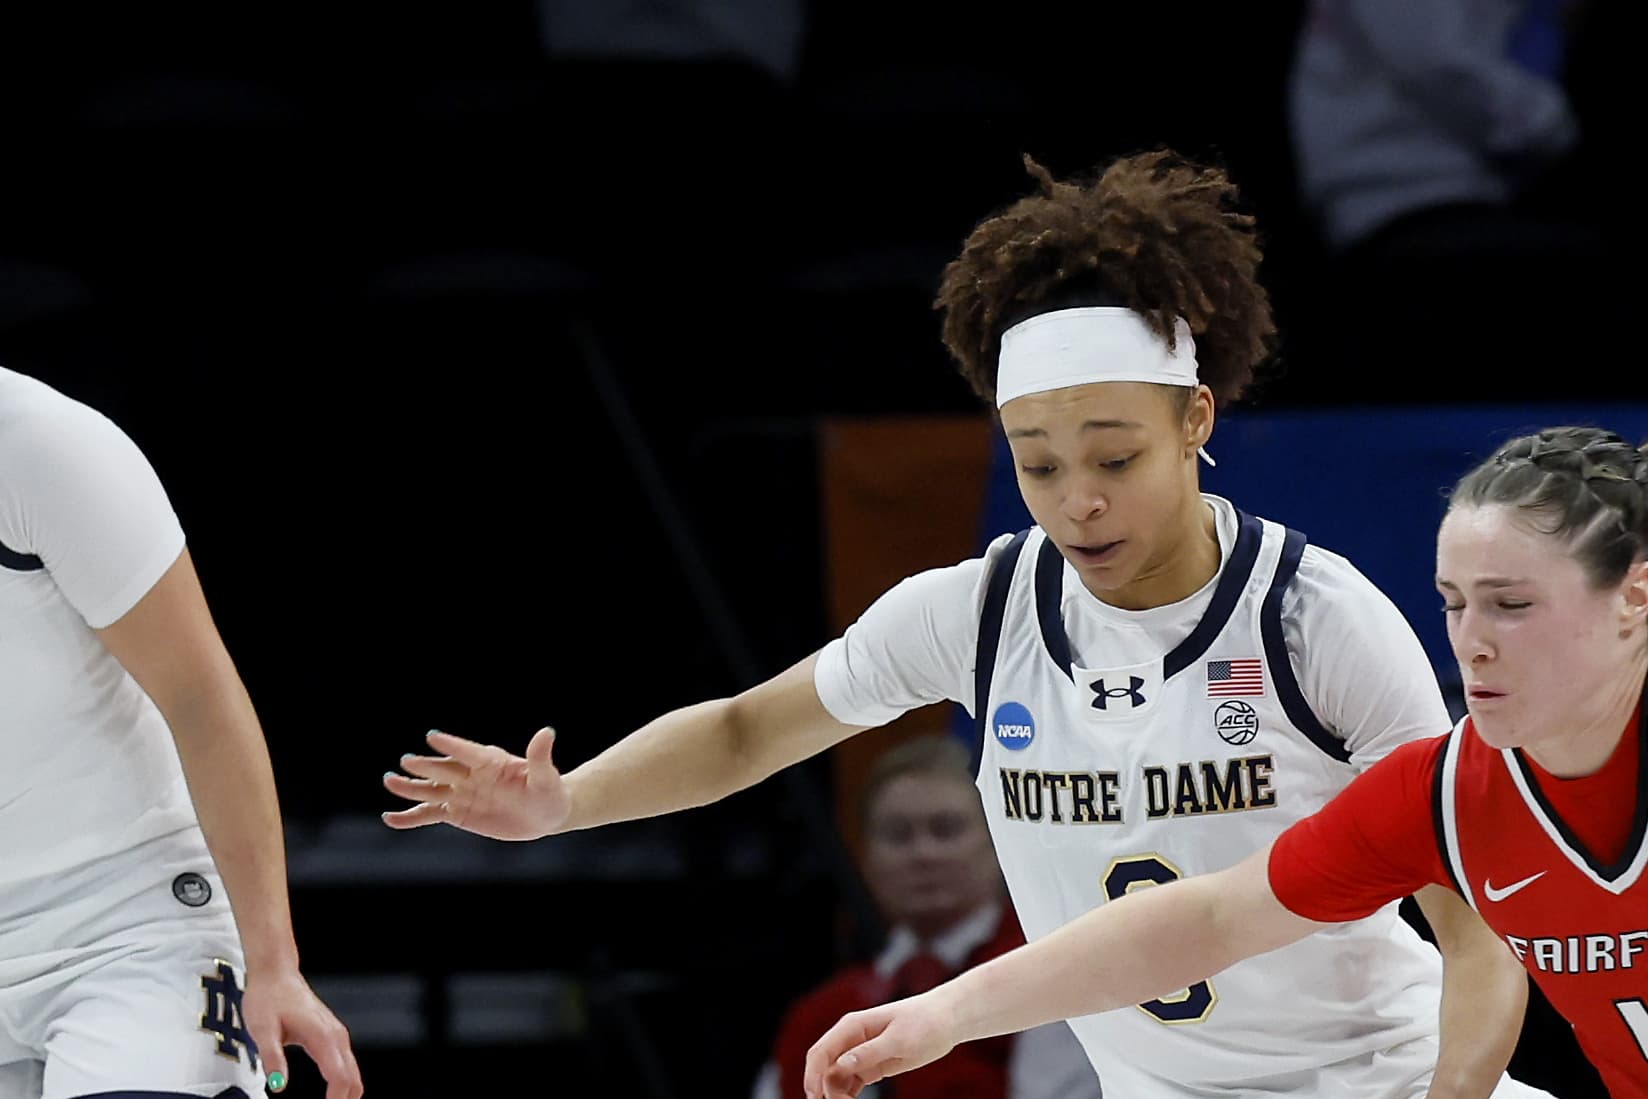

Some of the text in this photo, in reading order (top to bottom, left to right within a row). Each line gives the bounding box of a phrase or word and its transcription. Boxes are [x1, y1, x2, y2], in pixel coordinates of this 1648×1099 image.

[1220, 714, 1256, 727] ACC
[997, 723, 1033, 740] NCAA
[999, 753, 1279, 825] NOTRE DAME
